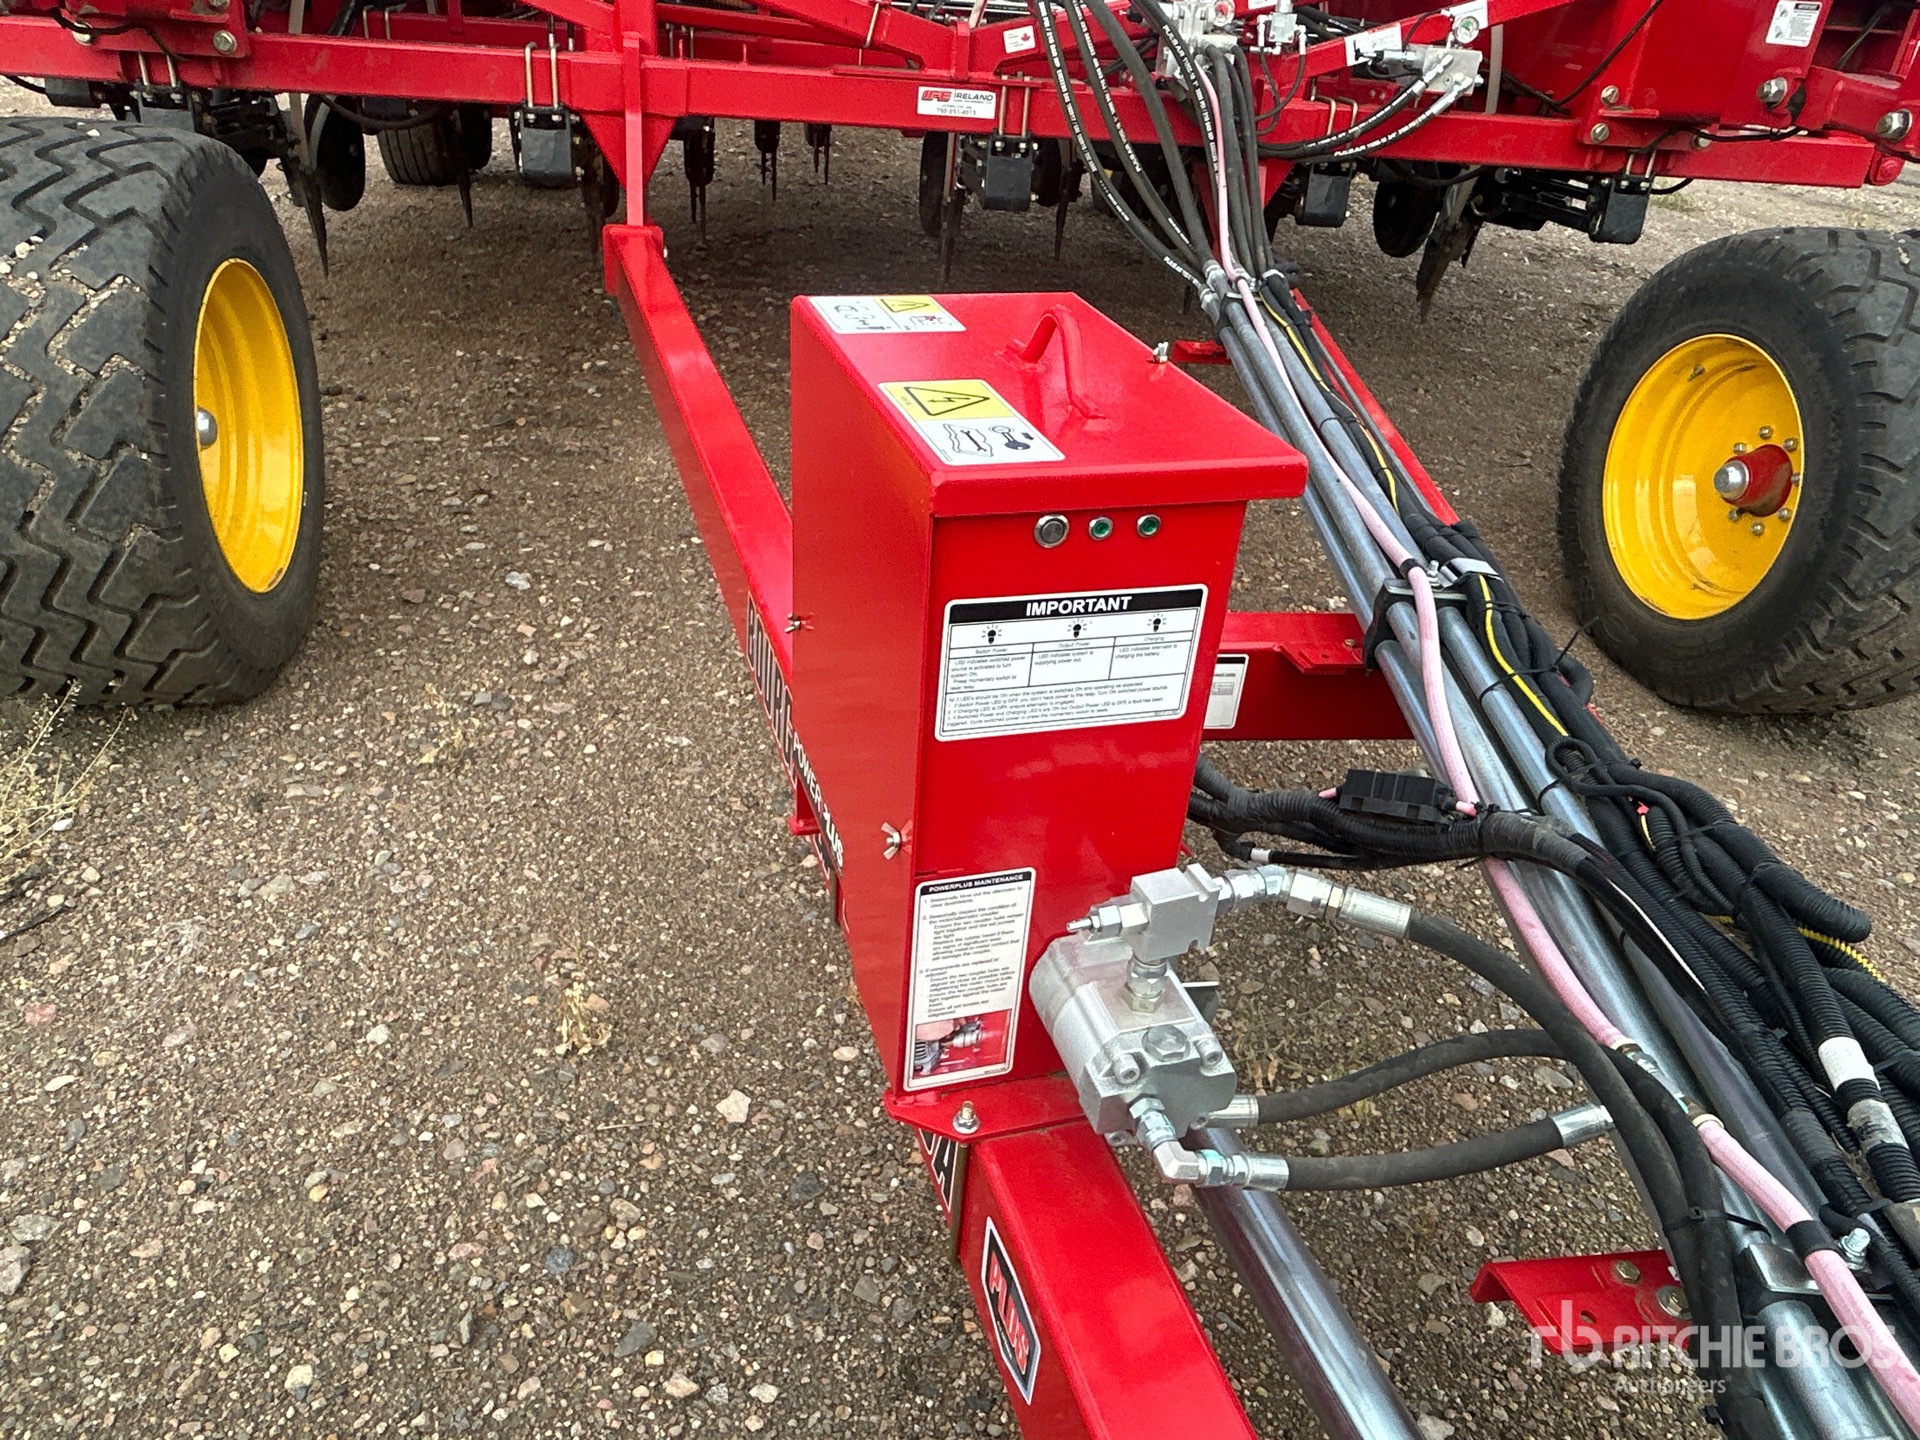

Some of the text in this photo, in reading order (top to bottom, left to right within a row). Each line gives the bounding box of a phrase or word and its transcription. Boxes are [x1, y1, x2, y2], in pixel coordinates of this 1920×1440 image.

[1162, 24, 1185, 59] PULSAR
[954, 92, 994, 102] IRELAND
[1334, 144, 1366, 157] PULSAR
[1026, 595, 1131, 616] IMPORTANT
[747, 591, 794, 788] BOURG
[794, 731, 822, 812] POWER
[928, 874, 1024, 892] POWERPLUS MAINTENANCE
[989, 1250, 1029, 1375] PLUS
